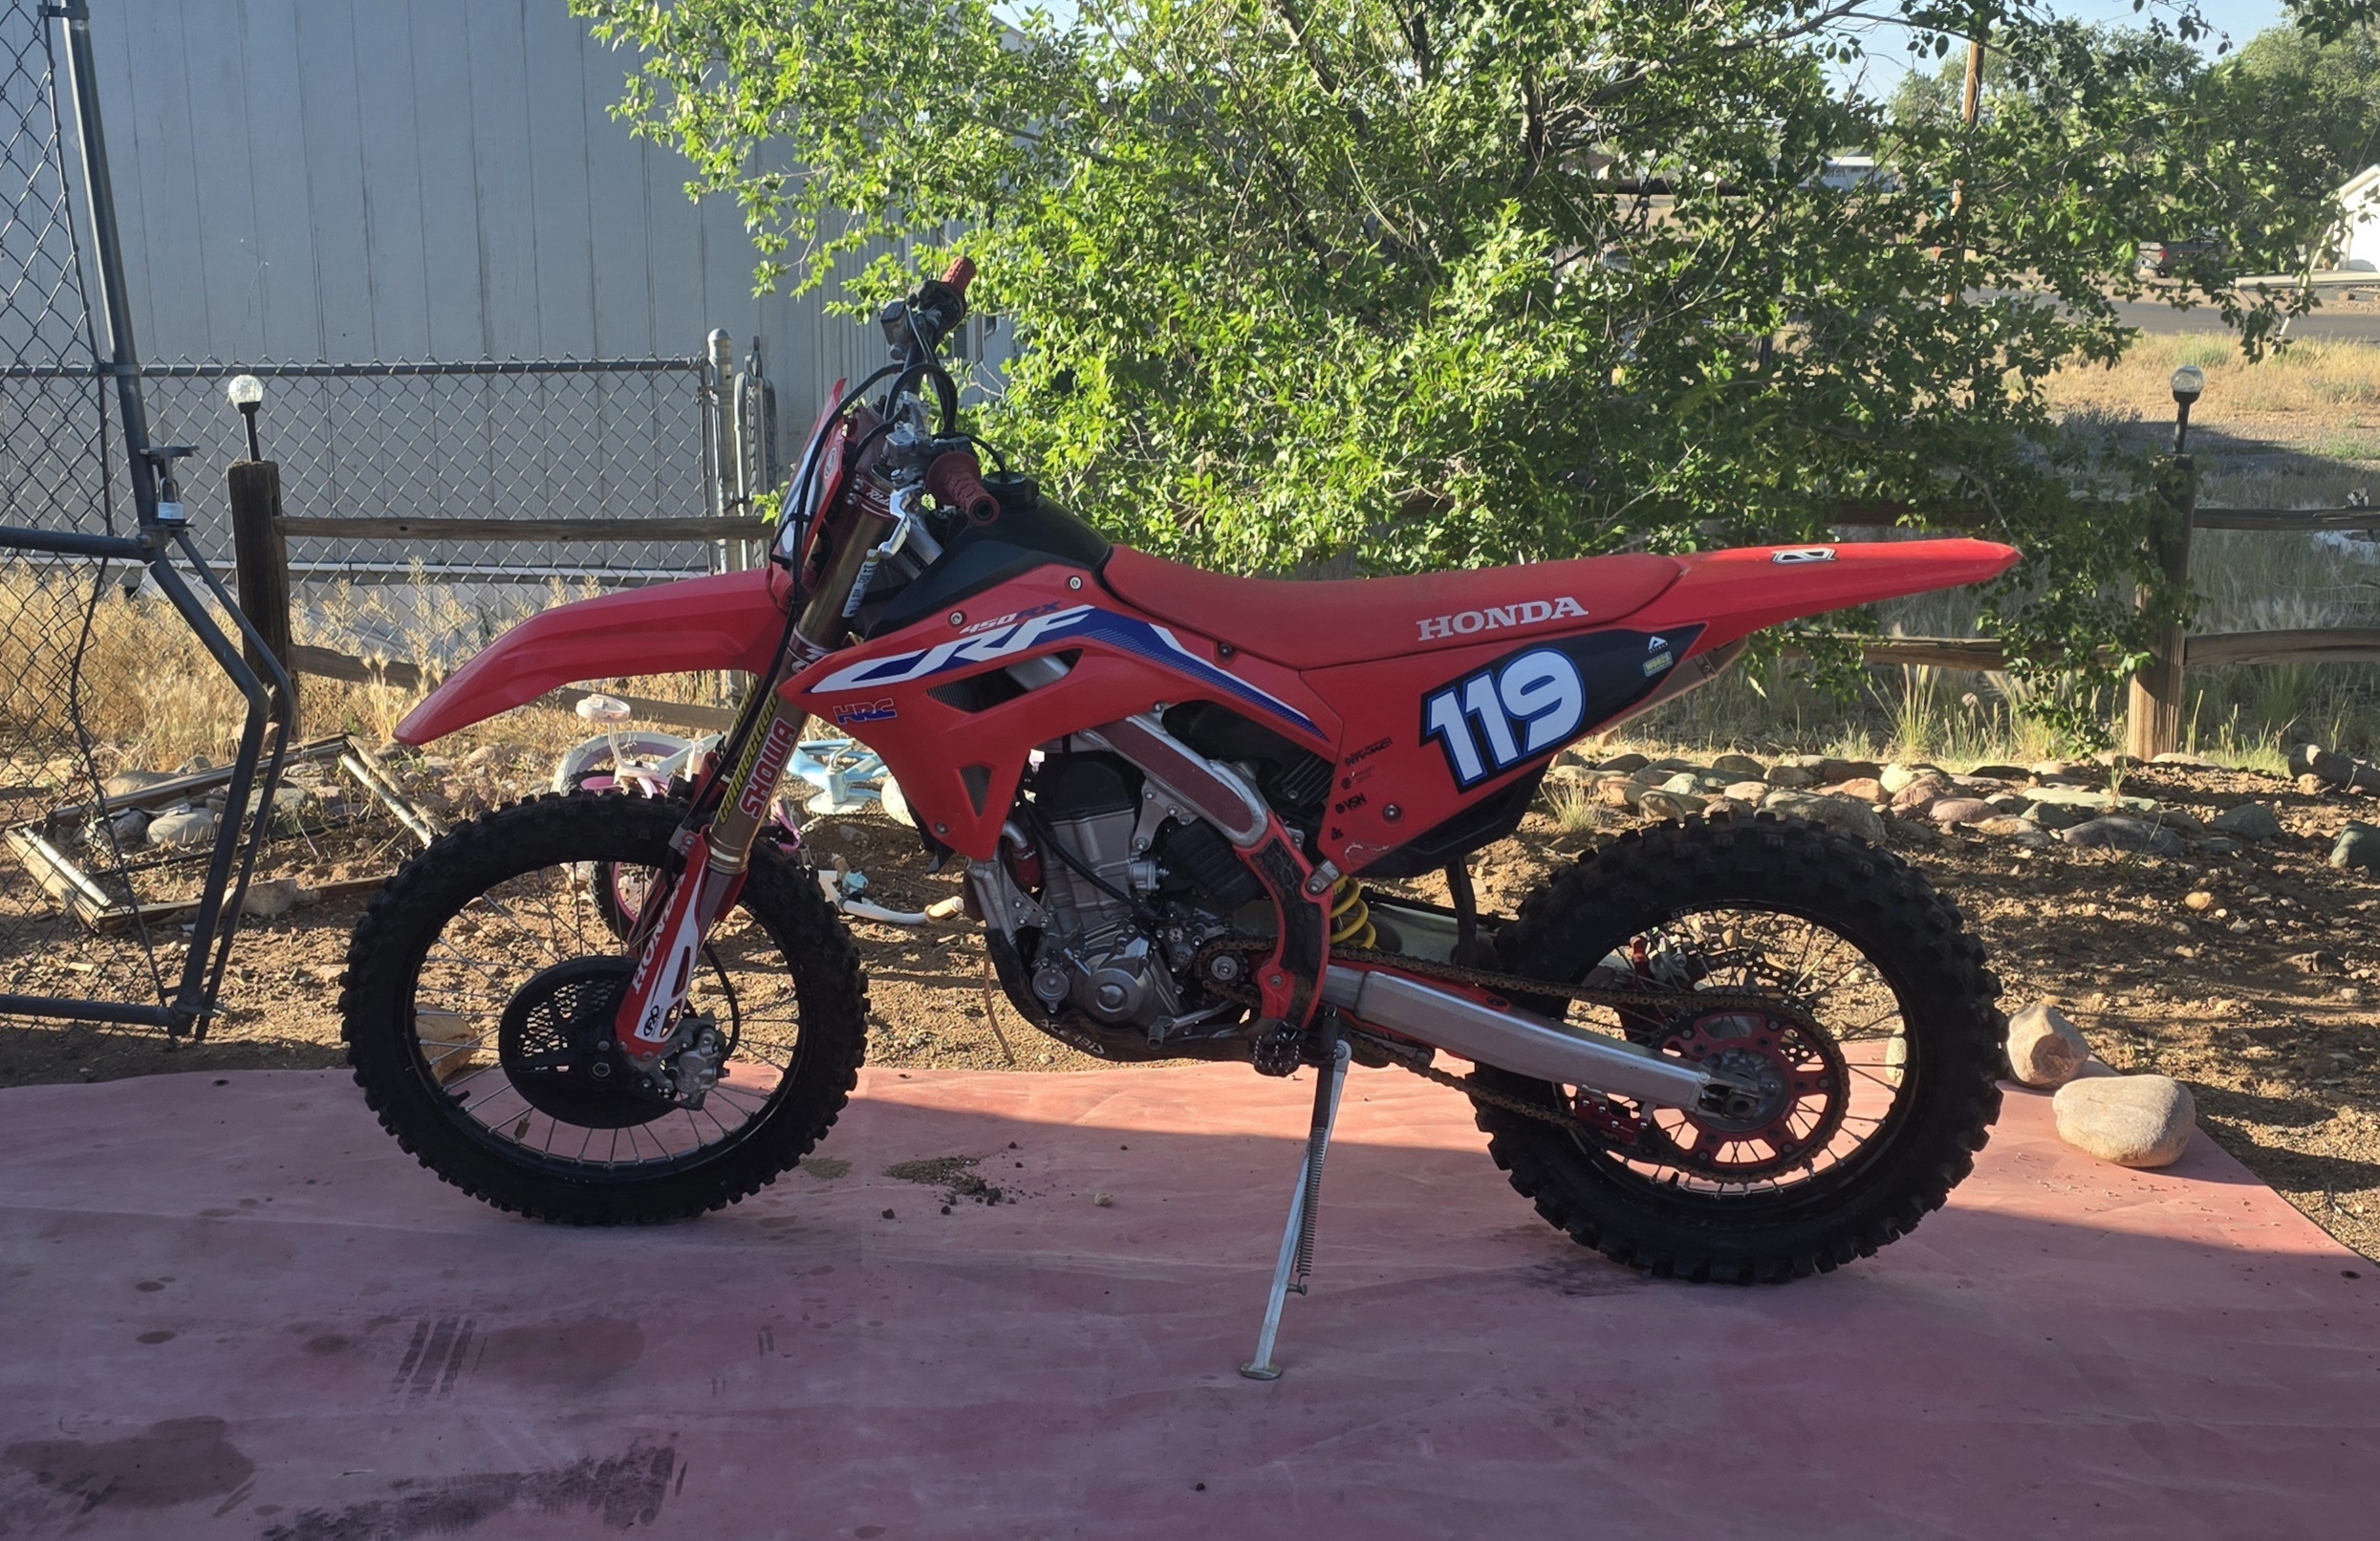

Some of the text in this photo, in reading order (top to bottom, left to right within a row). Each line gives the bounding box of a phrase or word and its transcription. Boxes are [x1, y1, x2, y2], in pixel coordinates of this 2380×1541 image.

[865, 488, 893, 508] Rid
[960, 600, 1062, 634] 450RX
[1417, 597, 1589, 641] HONDA
[811, 604, 1095, 693] CRF
[833, 698, 898, 725] HRC
[1426, 647, 1587, 786] 119
[738, 717, 797, 819] SHOWA
